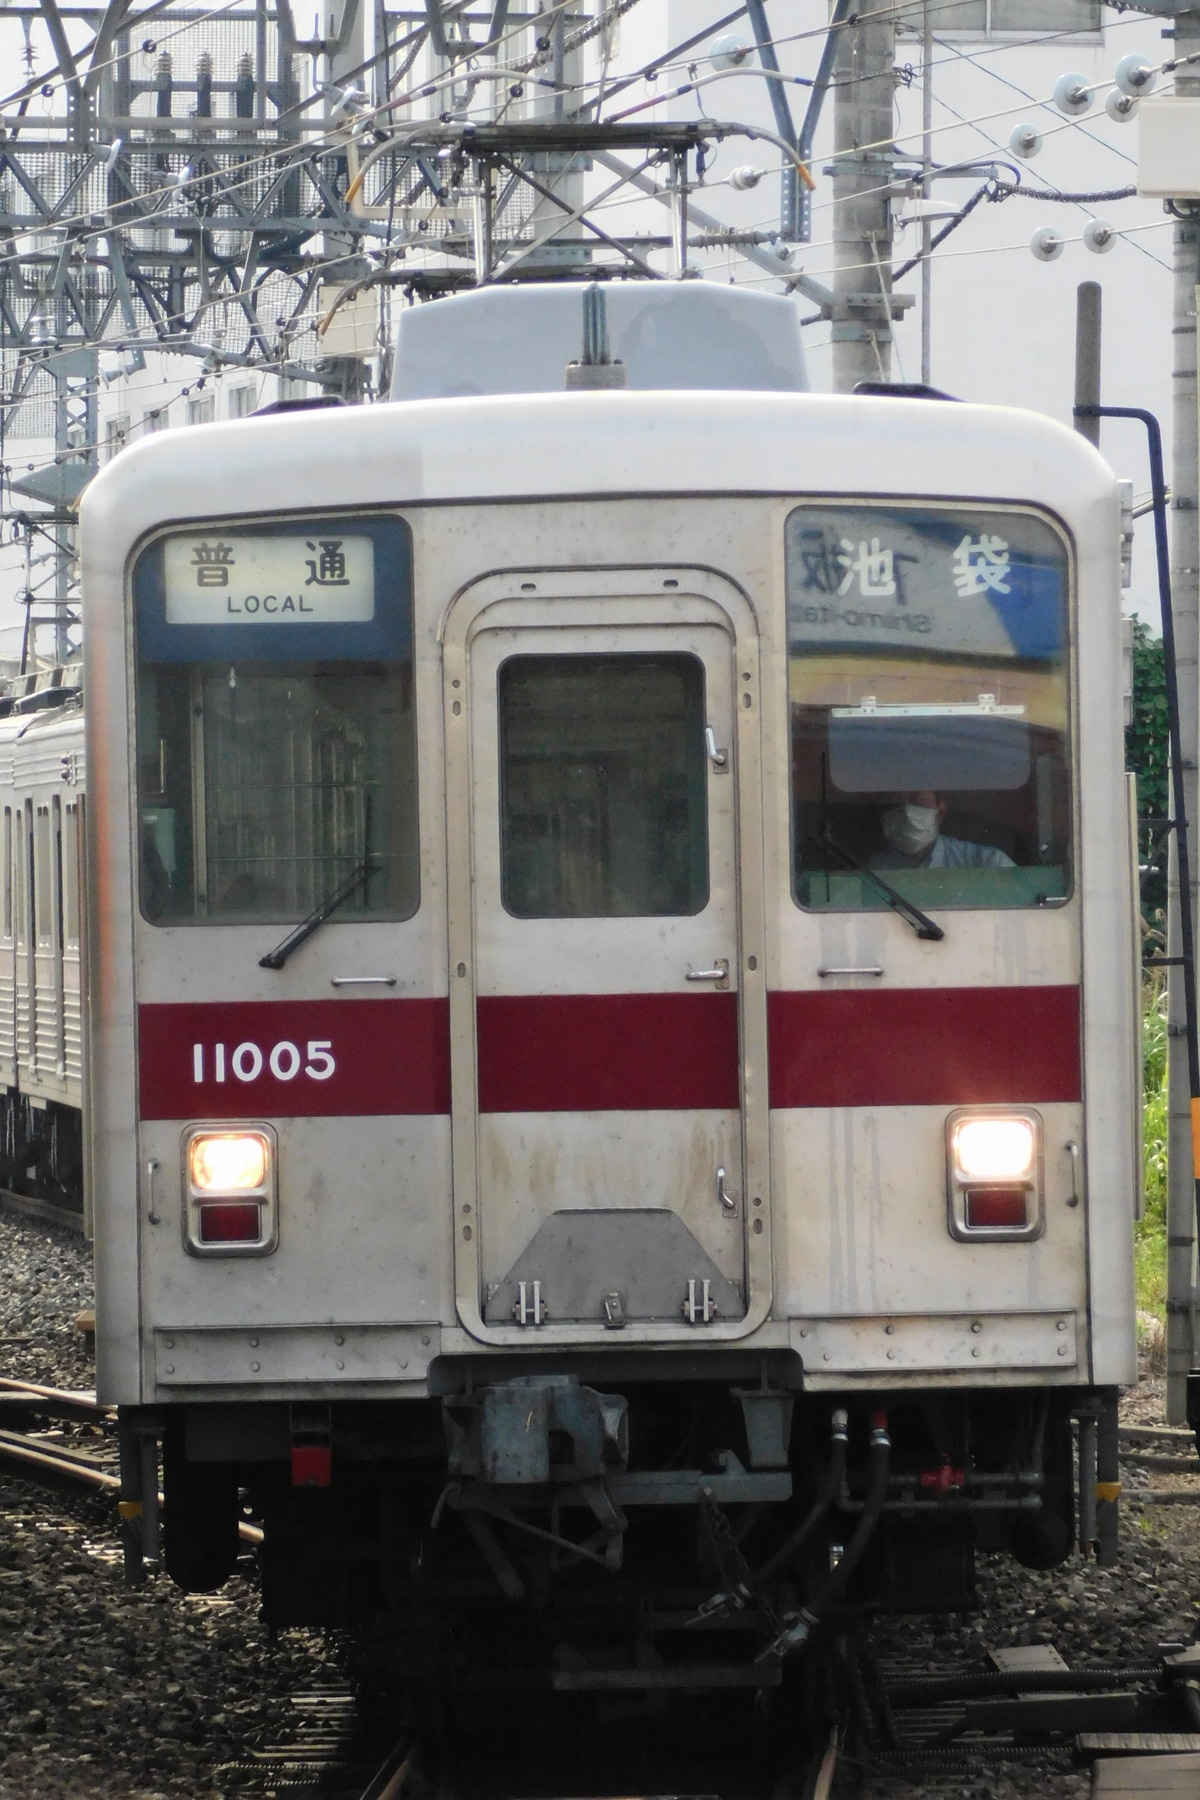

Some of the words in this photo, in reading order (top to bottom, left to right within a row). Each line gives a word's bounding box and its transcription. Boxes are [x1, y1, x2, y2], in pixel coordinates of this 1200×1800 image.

[190, 541, 350, 587] 普通
[837, 534, 1011, 597] 池袋
[227, 595, 314, 613] LOCAL
[193, 1040, 336, 1083] 11005
